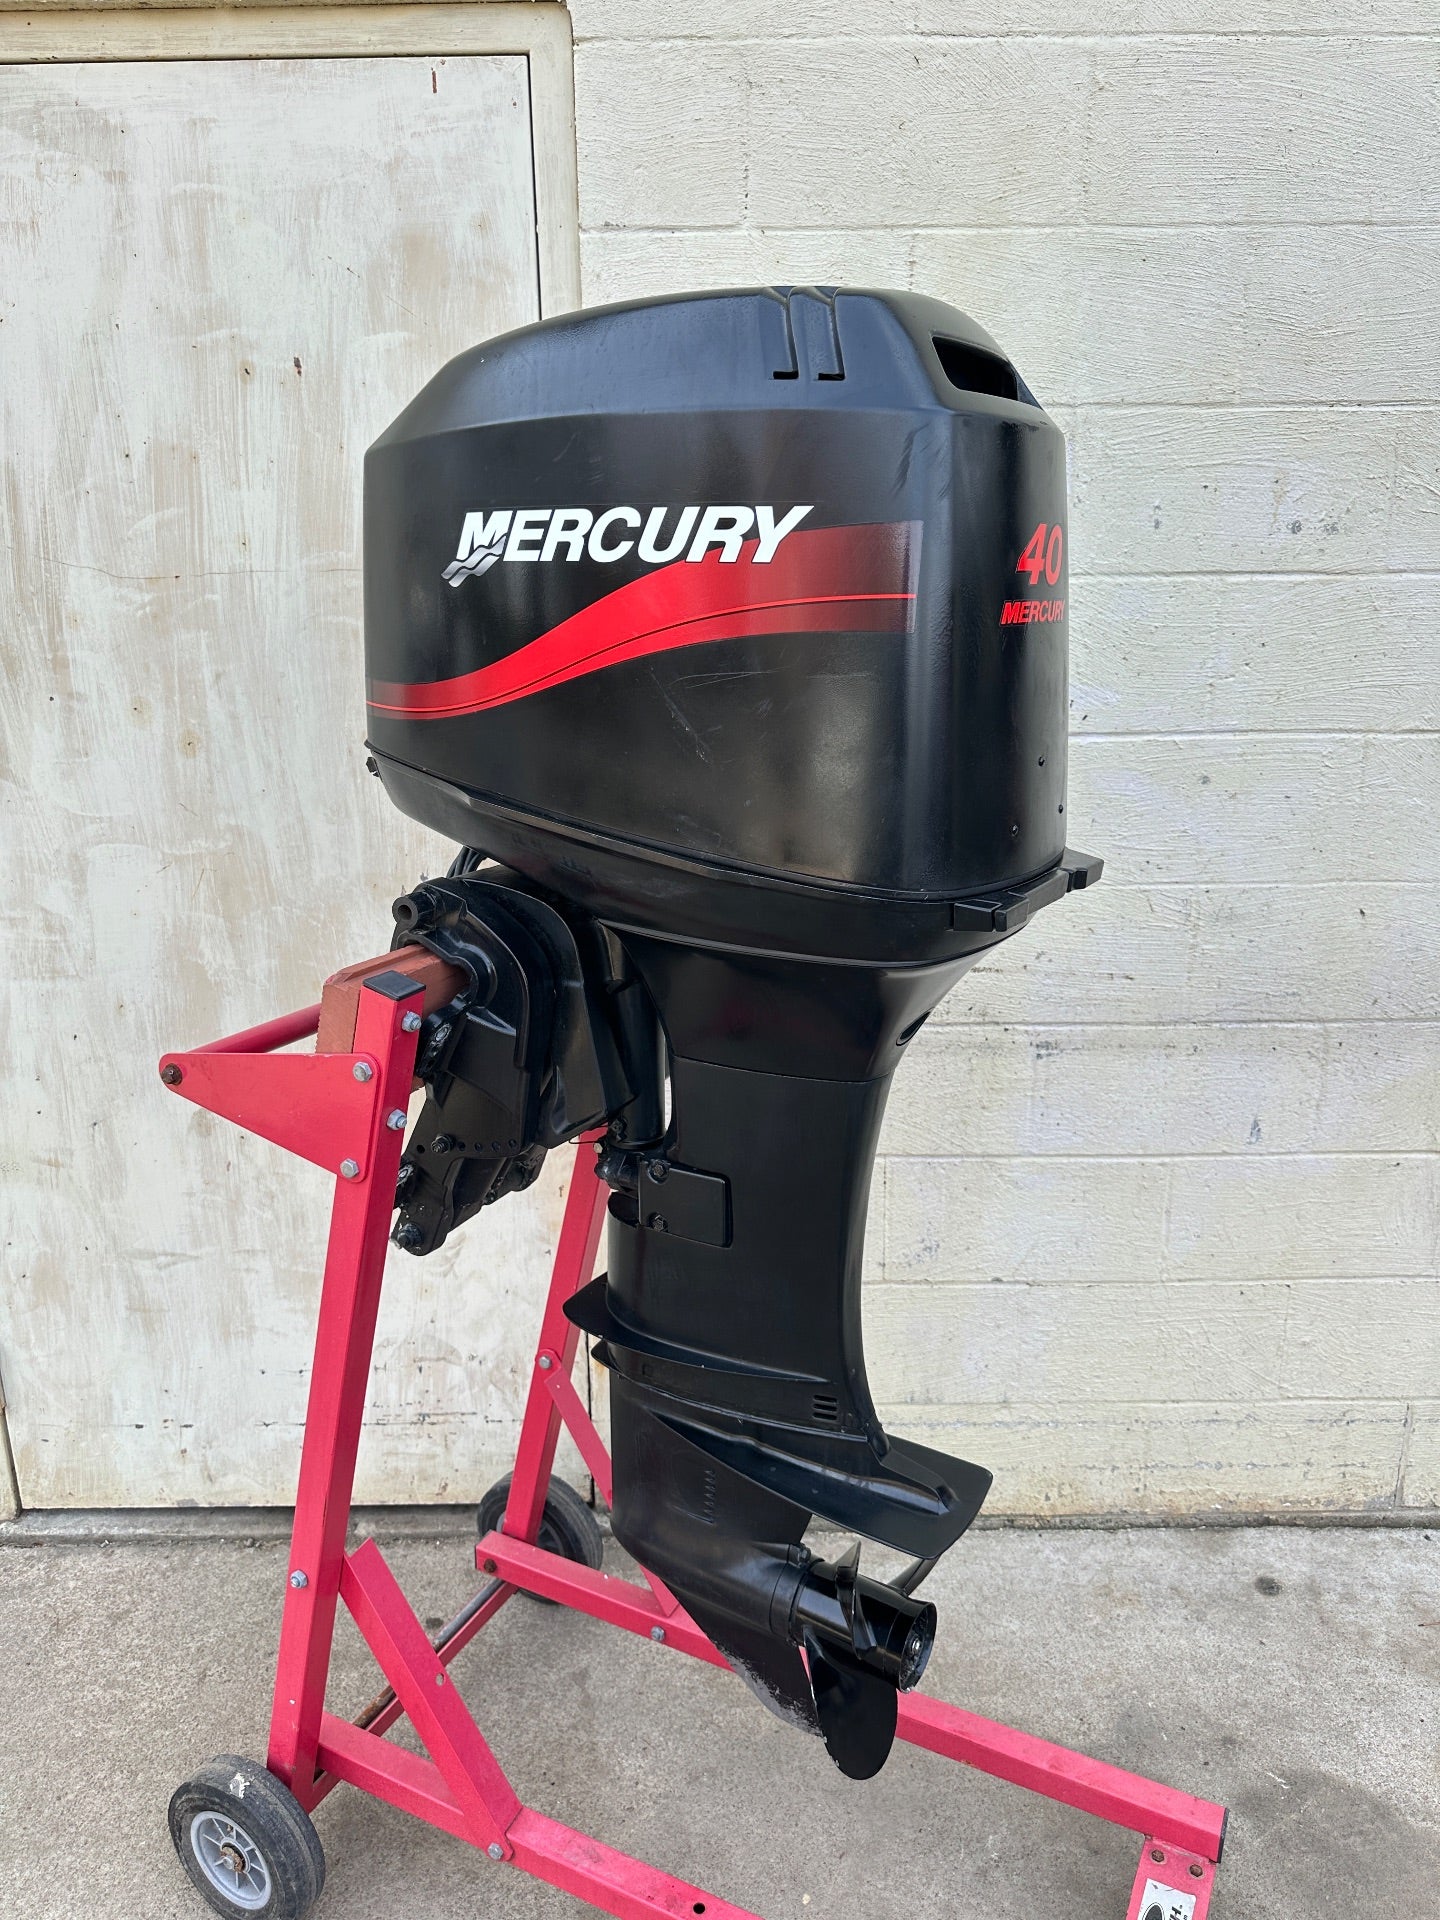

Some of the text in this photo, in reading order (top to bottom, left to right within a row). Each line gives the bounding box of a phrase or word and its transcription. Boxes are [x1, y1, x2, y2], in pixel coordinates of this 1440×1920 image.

[455, 505, 814, 565] MERCURY
[1016, 523, 1063, 586] 40
[1000, 600, 1065, 626] MERCURY
